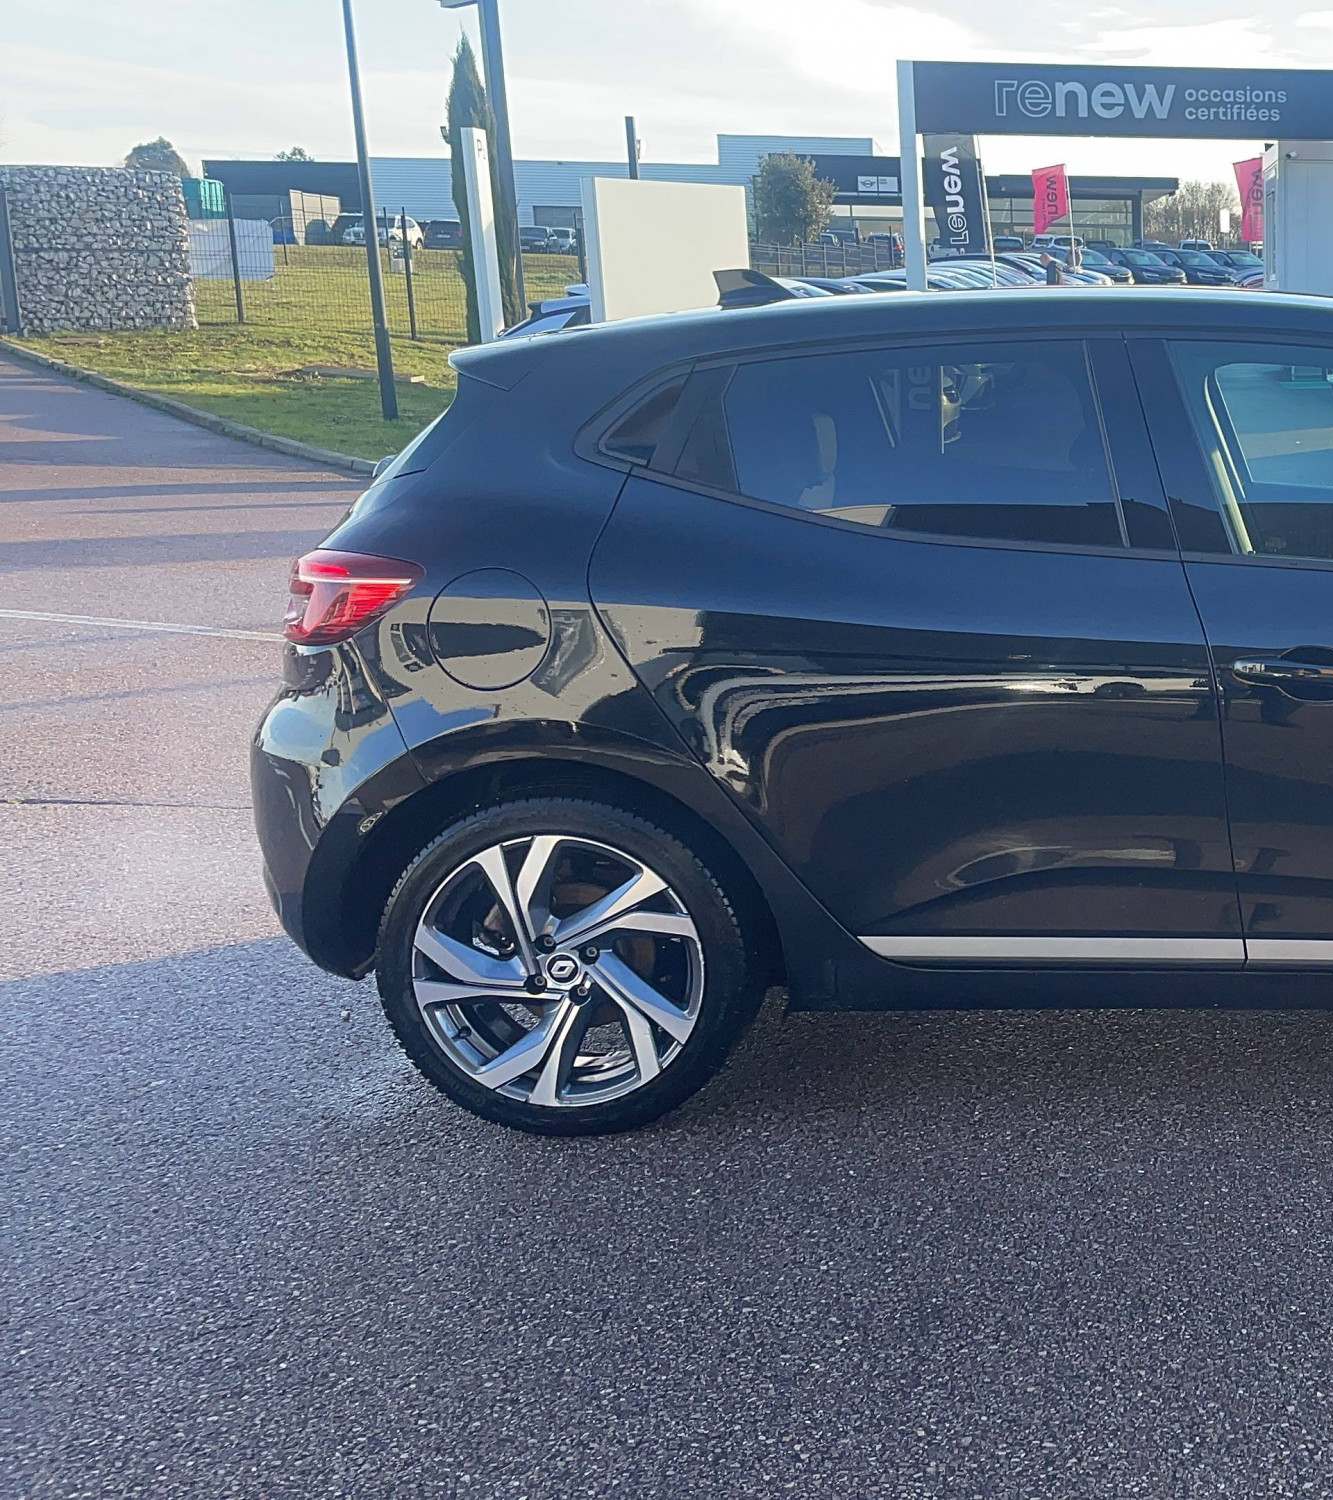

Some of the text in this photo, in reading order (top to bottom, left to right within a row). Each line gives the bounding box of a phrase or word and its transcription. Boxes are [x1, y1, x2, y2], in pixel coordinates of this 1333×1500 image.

[995, 80, 1176, 119] renew
[1184, 86, 1287, 103] occasions
[1184, 103, 1281, 121] certifiées
